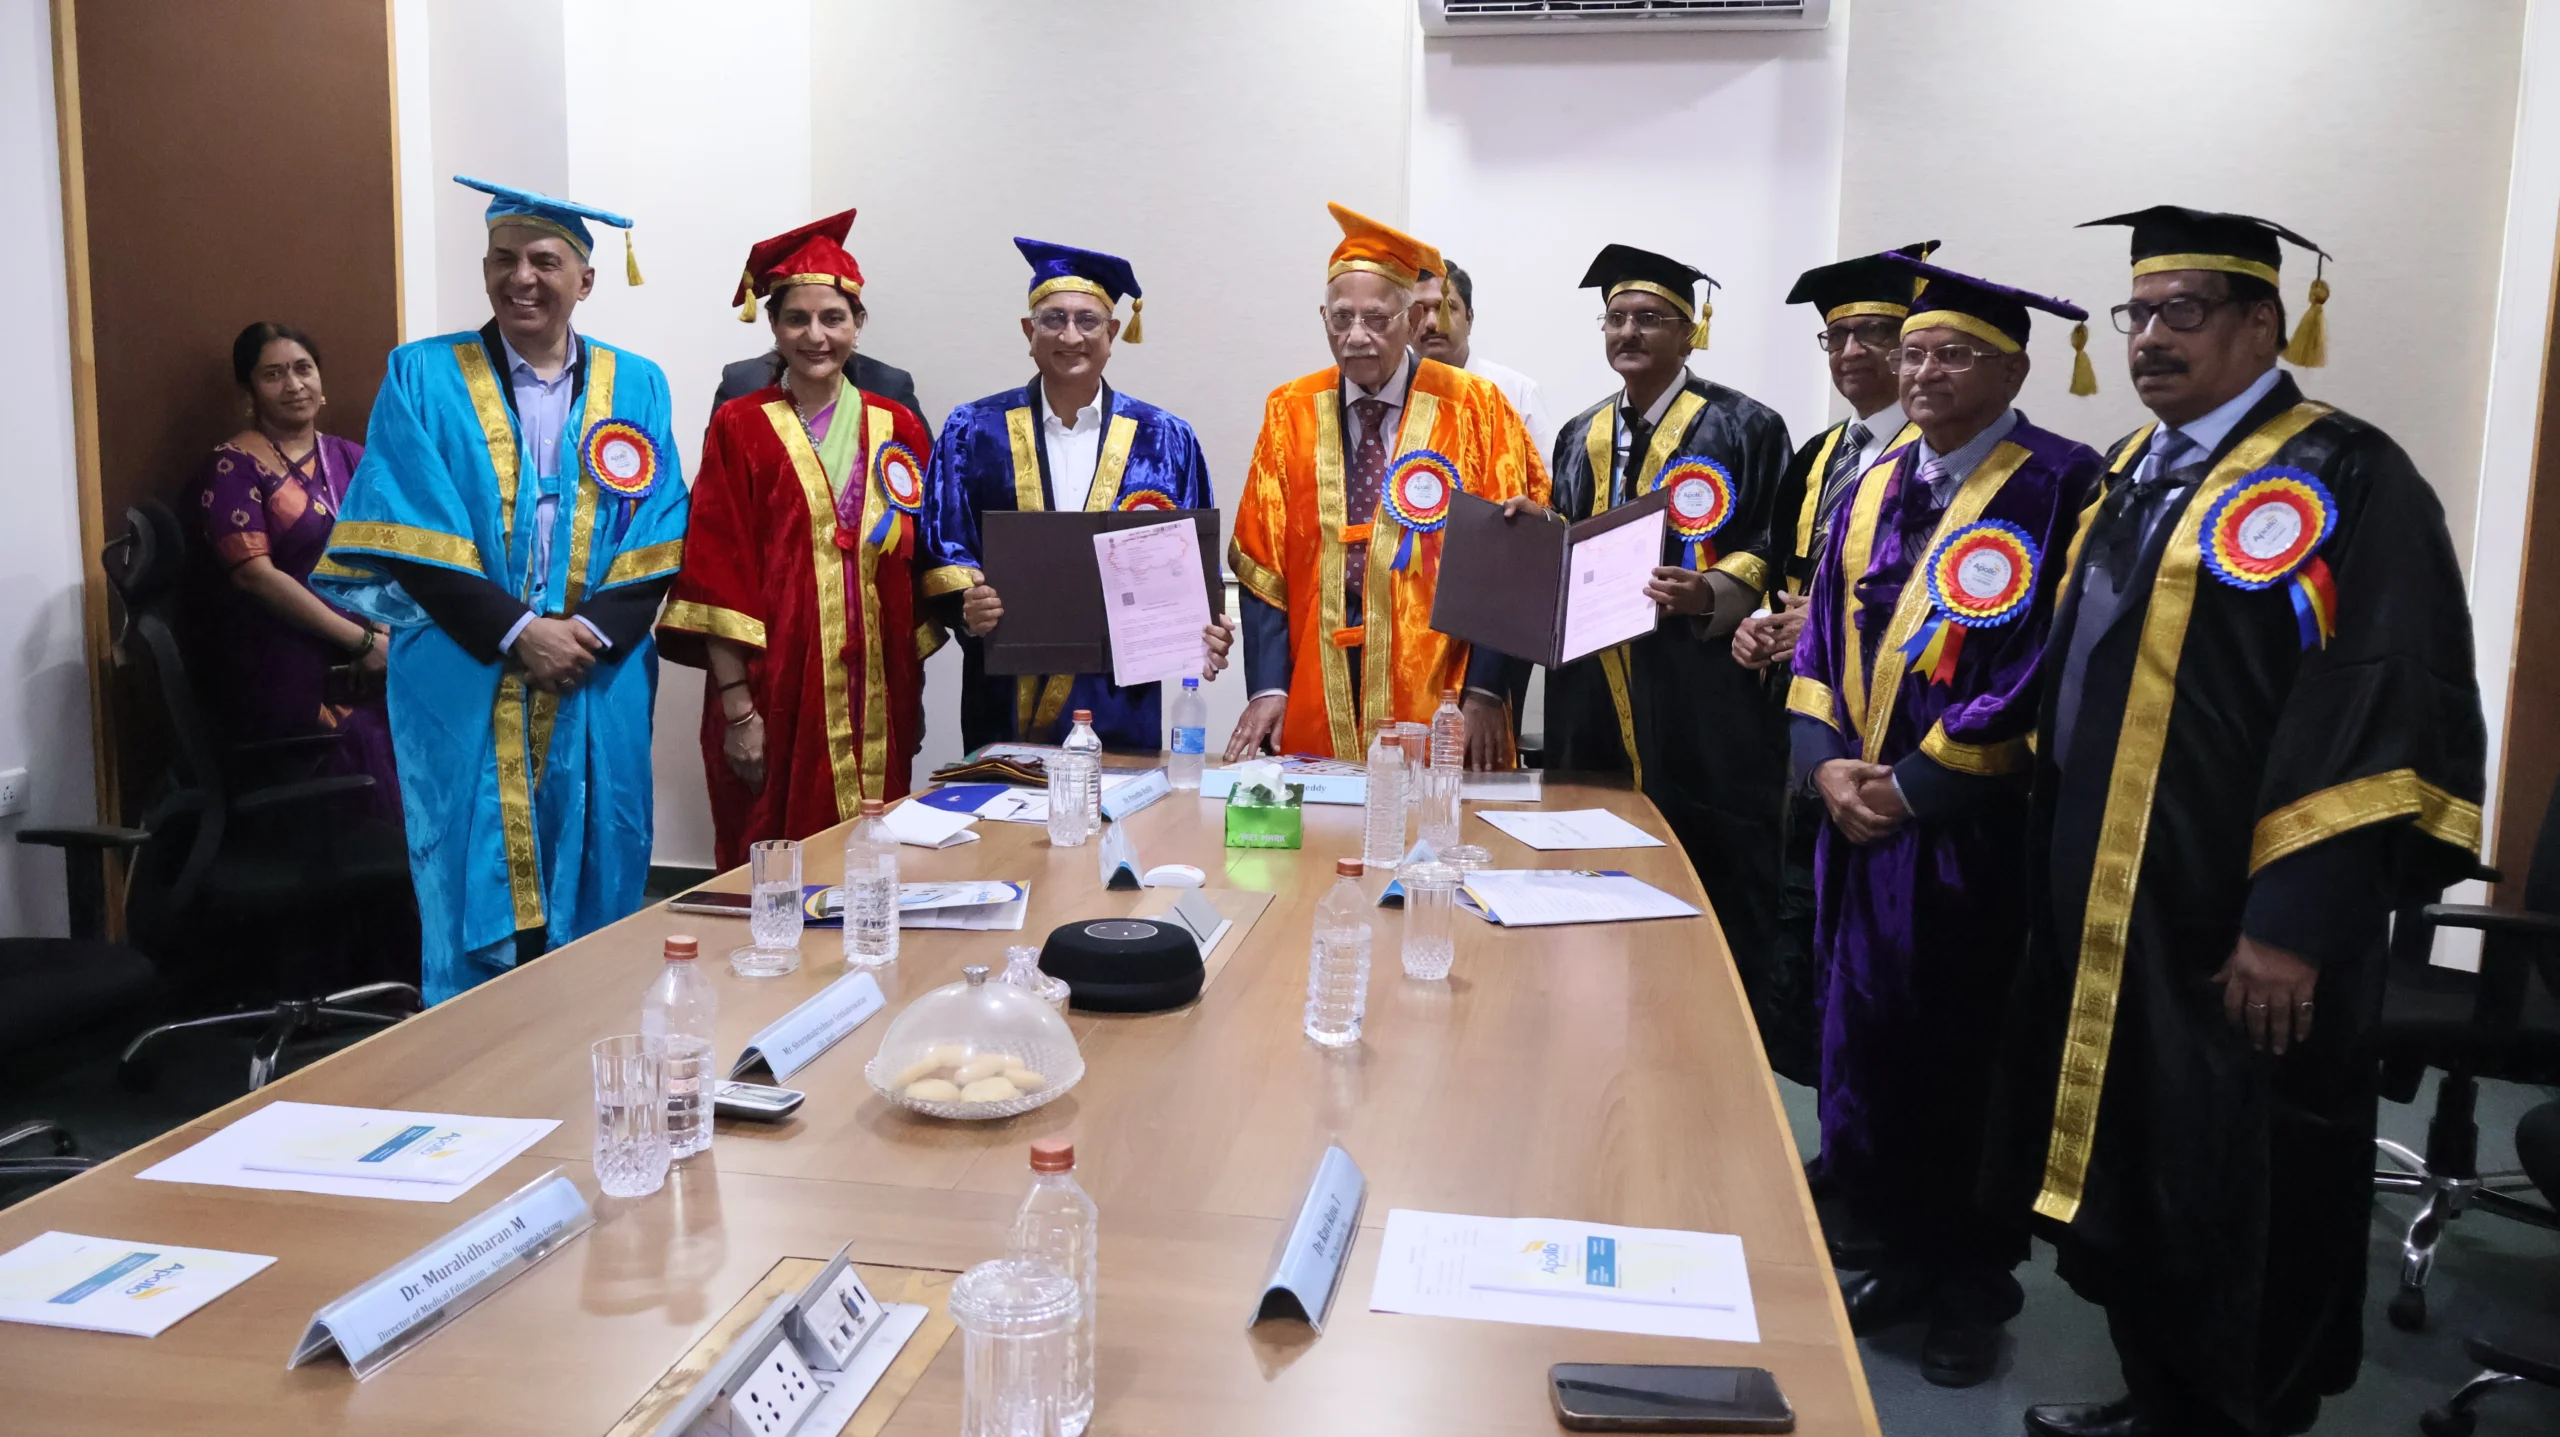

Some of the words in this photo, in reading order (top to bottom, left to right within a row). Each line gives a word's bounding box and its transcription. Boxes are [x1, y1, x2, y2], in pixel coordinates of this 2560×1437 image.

[1973, 562, 1998, 576] Apollo
[1305, 784, 1326, 793] eddy
[400, 1283, 425, 1303] Dr.
[421, 1223, 513, 1288] Muralidharan
[510, 1216, 527, 1233] M
[1541, 1242, 1567, 1275] Apollo
[125, 1262, 186, 1295] Apollo
[377, 1317, 411, 1342] Director
[412, 1309, 422, 1322] of
[420, 1290, 451, 1315] Medical
[449, 1268, 487, 1296] Education
[512, 1232, 544, 1257] Hospitals
[543, 1219, 564, 1236] Group
